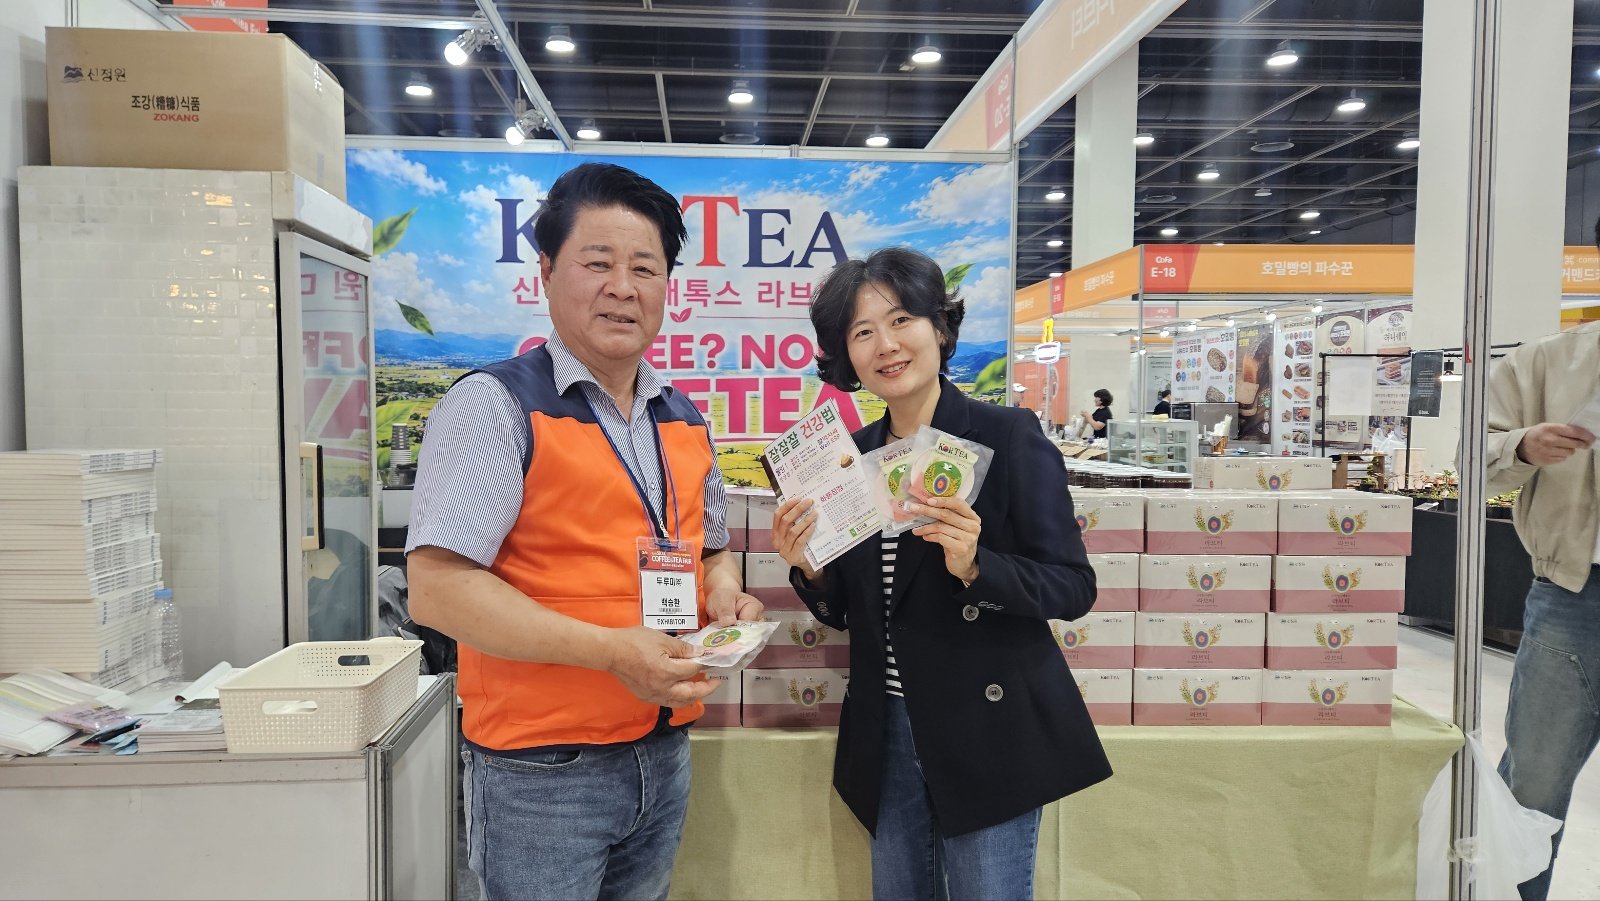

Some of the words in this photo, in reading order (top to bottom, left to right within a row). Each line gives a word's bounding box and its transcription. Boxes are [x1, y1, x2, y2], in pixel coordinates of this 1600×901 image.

[87, 67, 127, 83] 신정원
[153, 113, 200, 123] ZOKANG
[494, 195, 850, 268] KTEA
[1151, 267, 1177, 278] E-18
[1261, 261, 1312, 276] 호밀빵의
[1315, 261, 1354, 276] 파수꾼
[757, 281, 828, 308] 라브
[741, 334, 826, 370] NO
[768, 431, 801, 465] 잘잘잘
[800, 405, 836, 439] 건강법
[657, 618, 686, 626] EXHIBITOR
